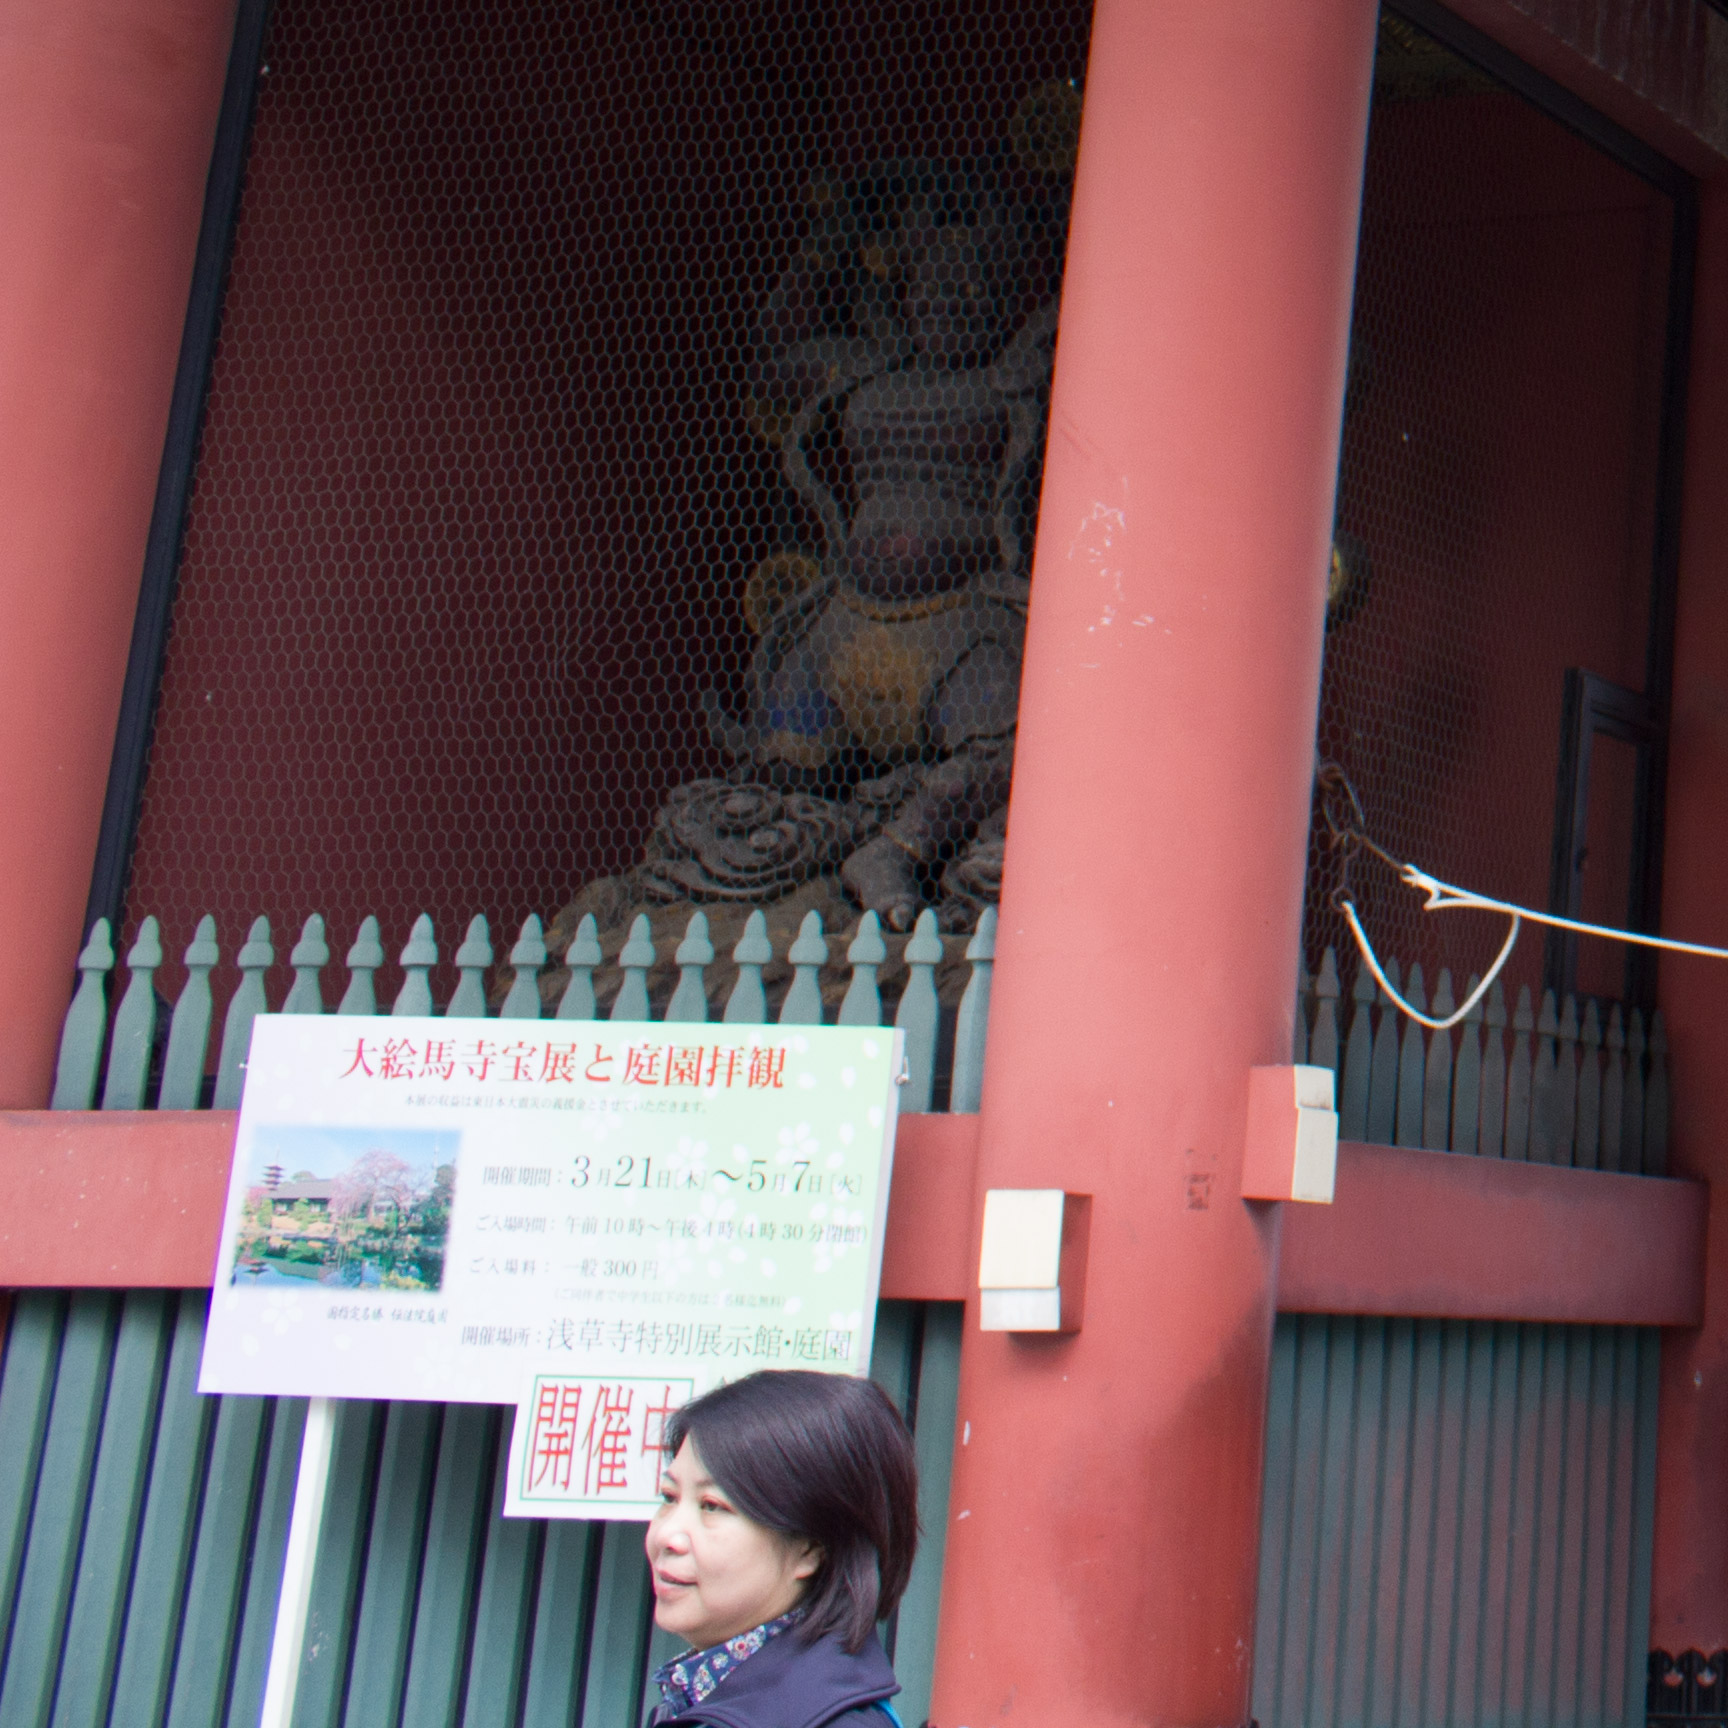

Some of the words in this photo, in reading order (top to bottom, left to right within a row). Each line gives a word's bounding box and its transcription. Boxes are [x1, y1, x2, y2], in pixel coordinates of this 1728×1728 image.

[338, 1037, 787, 1089] 大絵馬寺宝展と庭園拝観
